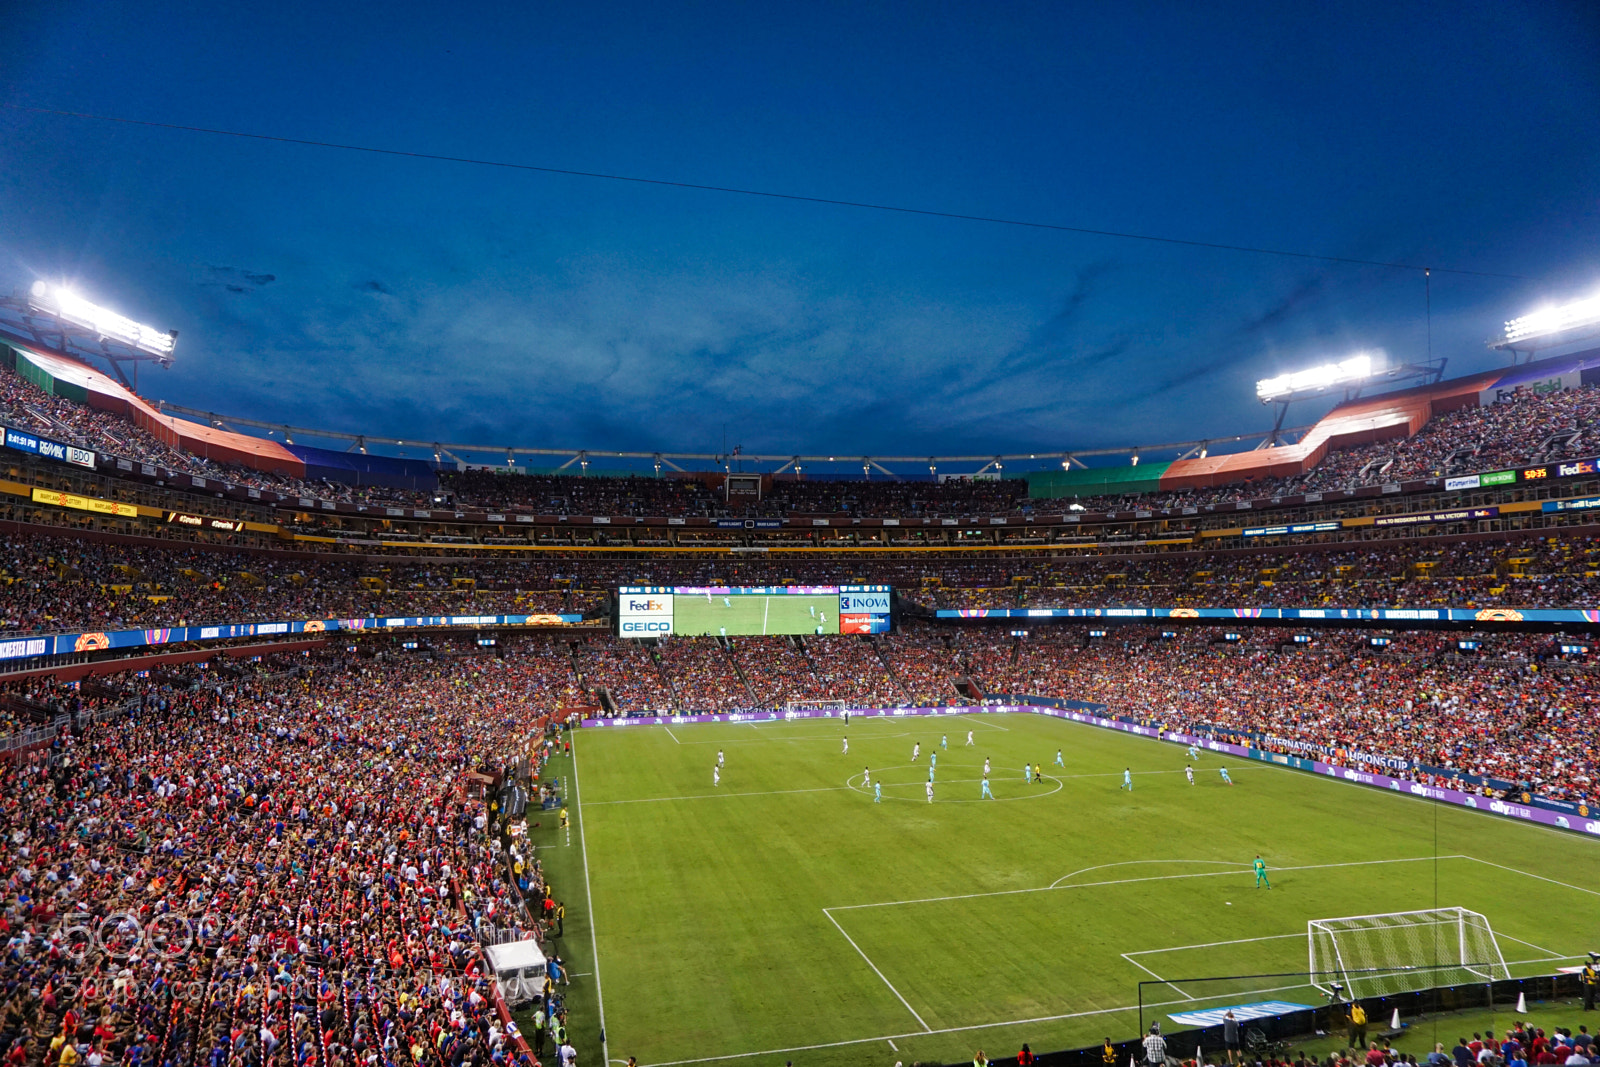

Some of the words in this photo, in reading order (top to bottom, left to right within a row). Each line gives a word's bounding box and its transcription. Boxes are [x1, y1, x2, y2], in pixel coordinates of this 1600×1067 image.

[39, 440, 65, 459] RE/MAX
[74, 449, 90, 463] BDO
[1559, 462, 1594, 476] FedEx
[630, 600, 663, 611] FedEx
[852, 597, 888, 608] INOVA
[622, 622, 670, 632] GEICO
[1329, 747, 1386, 767] CAMPIONS
[1387, 758, 1409, 771] CUP
[1410, 783, 1427, 797] ally
[1489, 800, 1510, 816] ally
